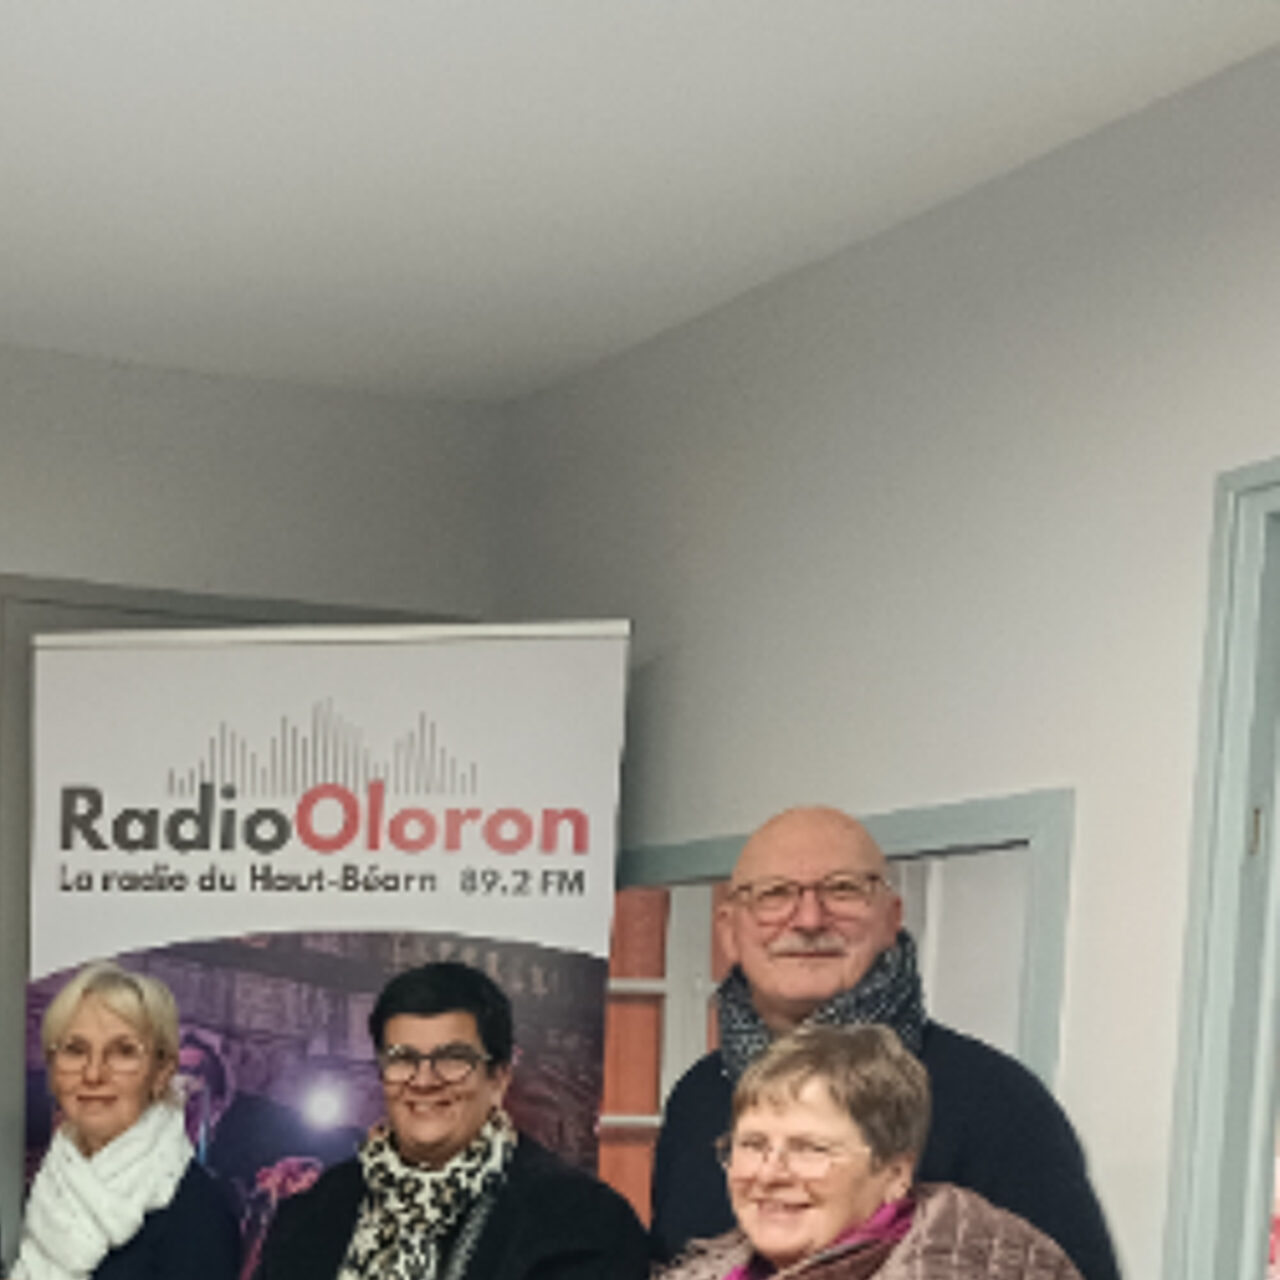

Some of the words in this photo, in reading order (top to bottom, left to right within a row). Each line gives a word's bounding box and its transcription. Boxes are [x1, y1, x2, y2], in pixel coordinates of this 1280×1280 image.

[60, 780, 590, 855] RadioOloron
[60, 864, 93, 892] La
[102, 863, 188, 892] radio
[199, 864, 237, 892] du
[250, 863, 437, 893] Haut-Béarn
[460, 867, 532, 896] 89.2
[541, 869, 586, 896] FM
